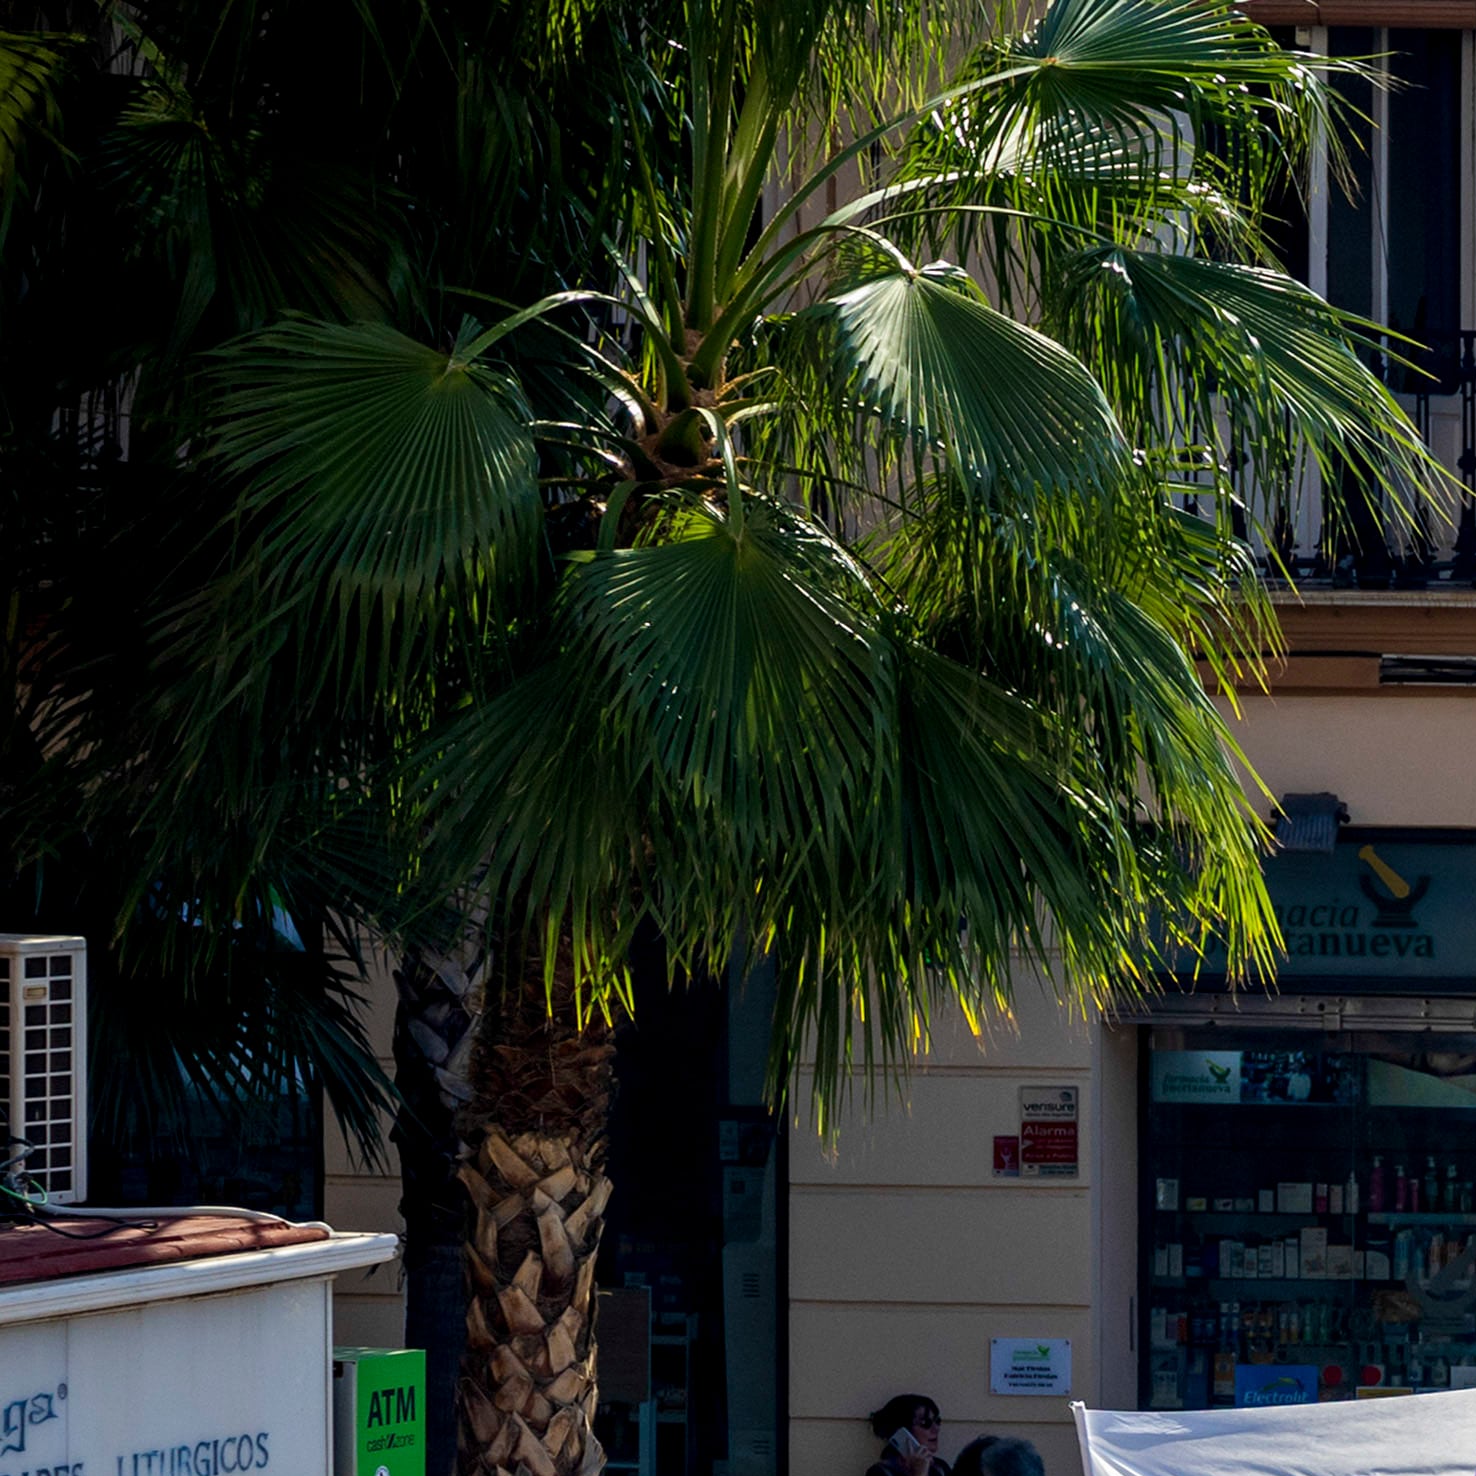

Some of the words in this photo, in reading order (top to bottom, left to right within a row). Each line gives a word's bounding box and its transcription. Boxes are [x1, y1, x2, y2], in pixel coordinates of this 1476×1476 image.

[1278, 897, 1360, 928] acia
[1024, 1125, 1075, 1136] Alarma
[367, 1385, 416, 1428] ATM
